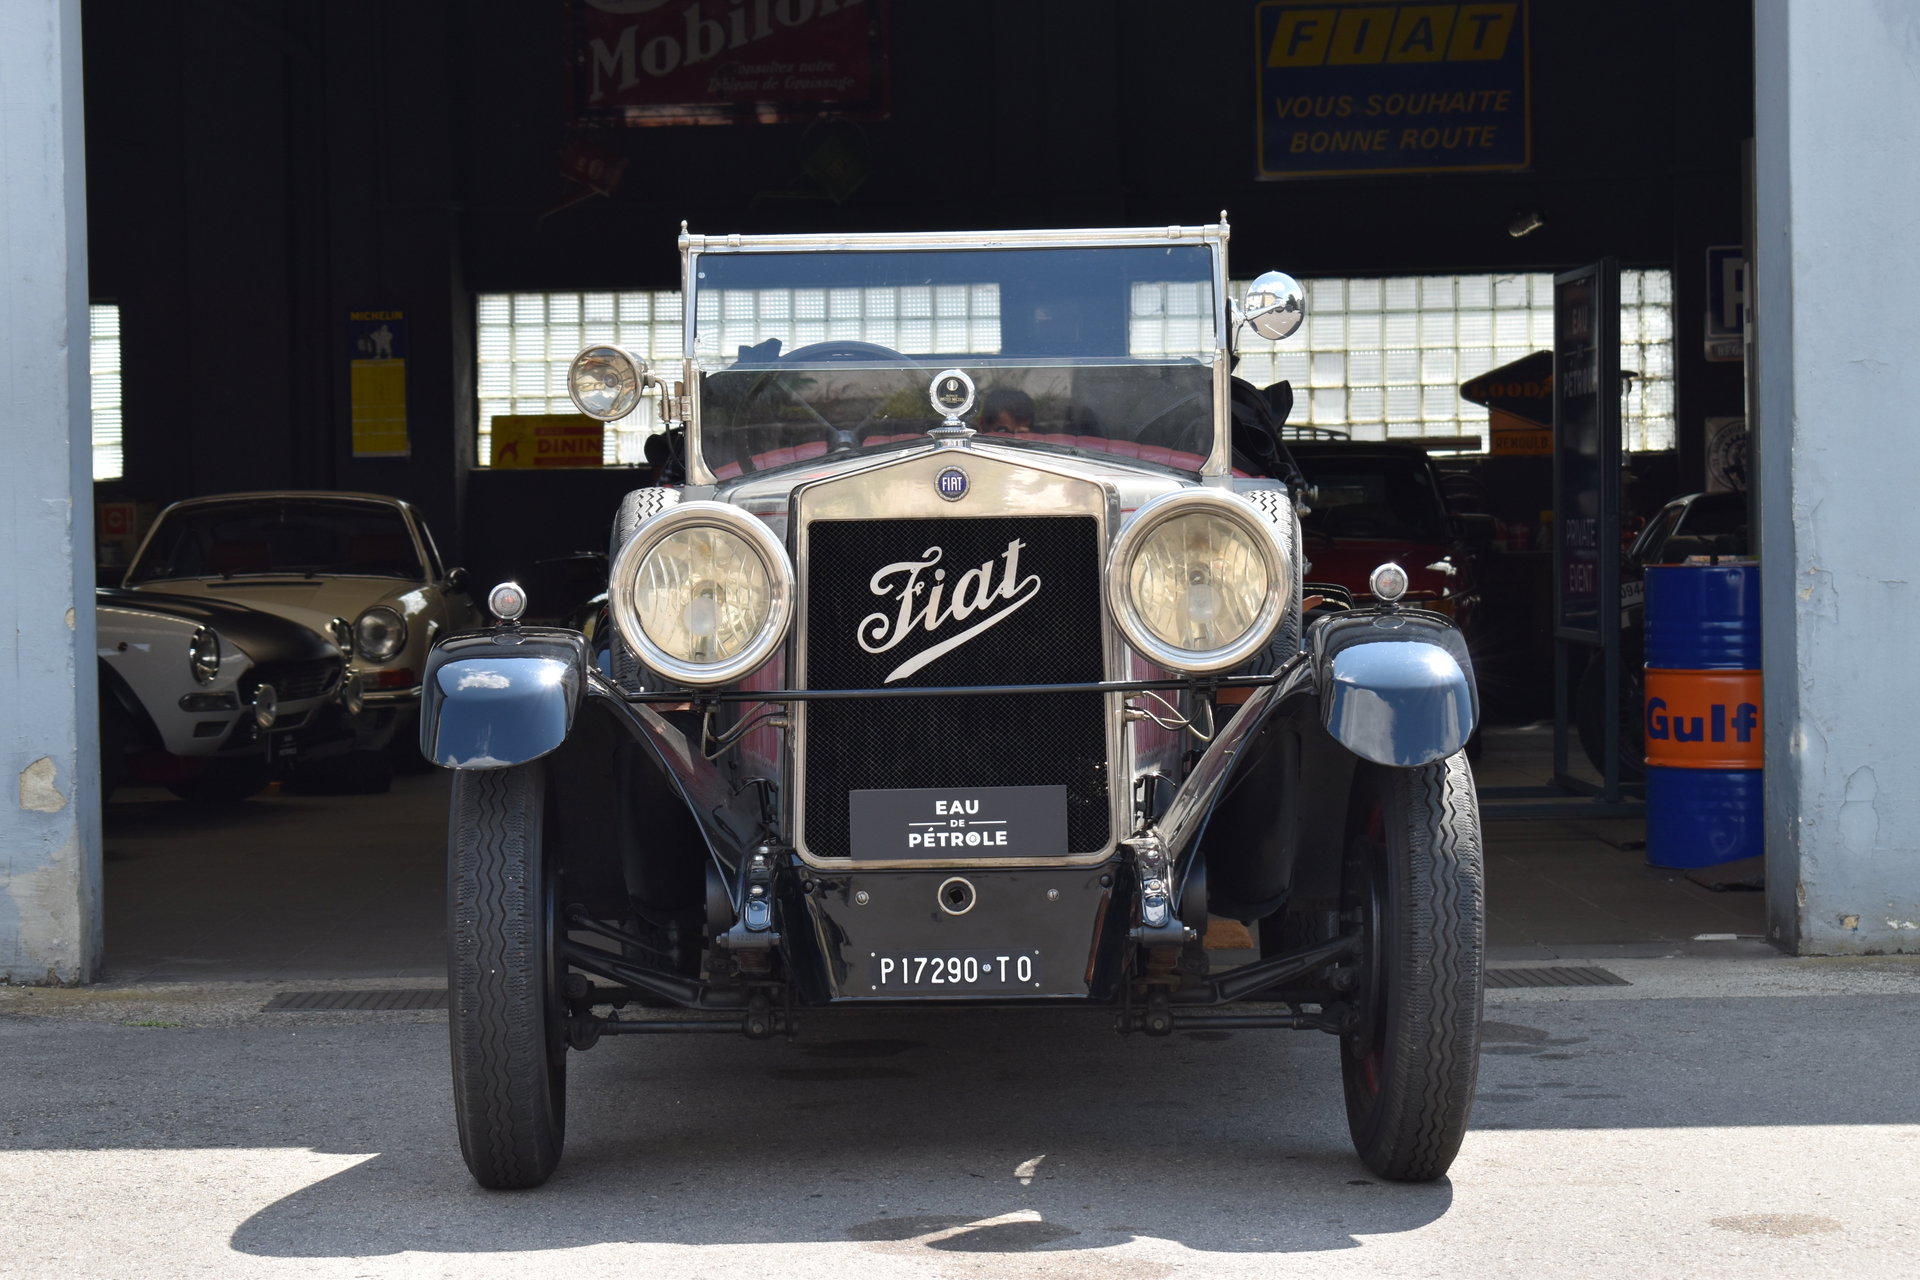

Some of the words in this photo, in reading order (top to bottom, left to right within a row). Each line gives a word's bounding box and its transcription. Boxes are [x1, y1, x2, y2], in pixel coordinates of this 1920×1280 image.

[1284, 13, 1504, 58] FIAT
[588, 0, 865, 102] Mobilo
[762, 76, 779, 90] de
[784, 75, 855, 92] Graissage
[1276, 95, 1352, 118] VOUS
[1365, 90, 1512, 116] SOUHAITE
[1289, 129, 1390, 154] BONNE
[1400, 126, 1497, 150] ROUTE
[350, 311, 403, 321] MICHELIN
[942, 476, 963, 491] FIAT
[1566, 519, 1596, 547] PRIVATE
[1569, 564, 1593, 592] EVENT
[857, 538, 1041, 684] Fiat
[1646, 697, 1757, 743] Gulf
[935, 799, 980, 815] EAU
[950, 819, 965, 827] DE
[909, 827, 1008, 848] PÉTROLE
[881, 956, 978, 984] P17290
